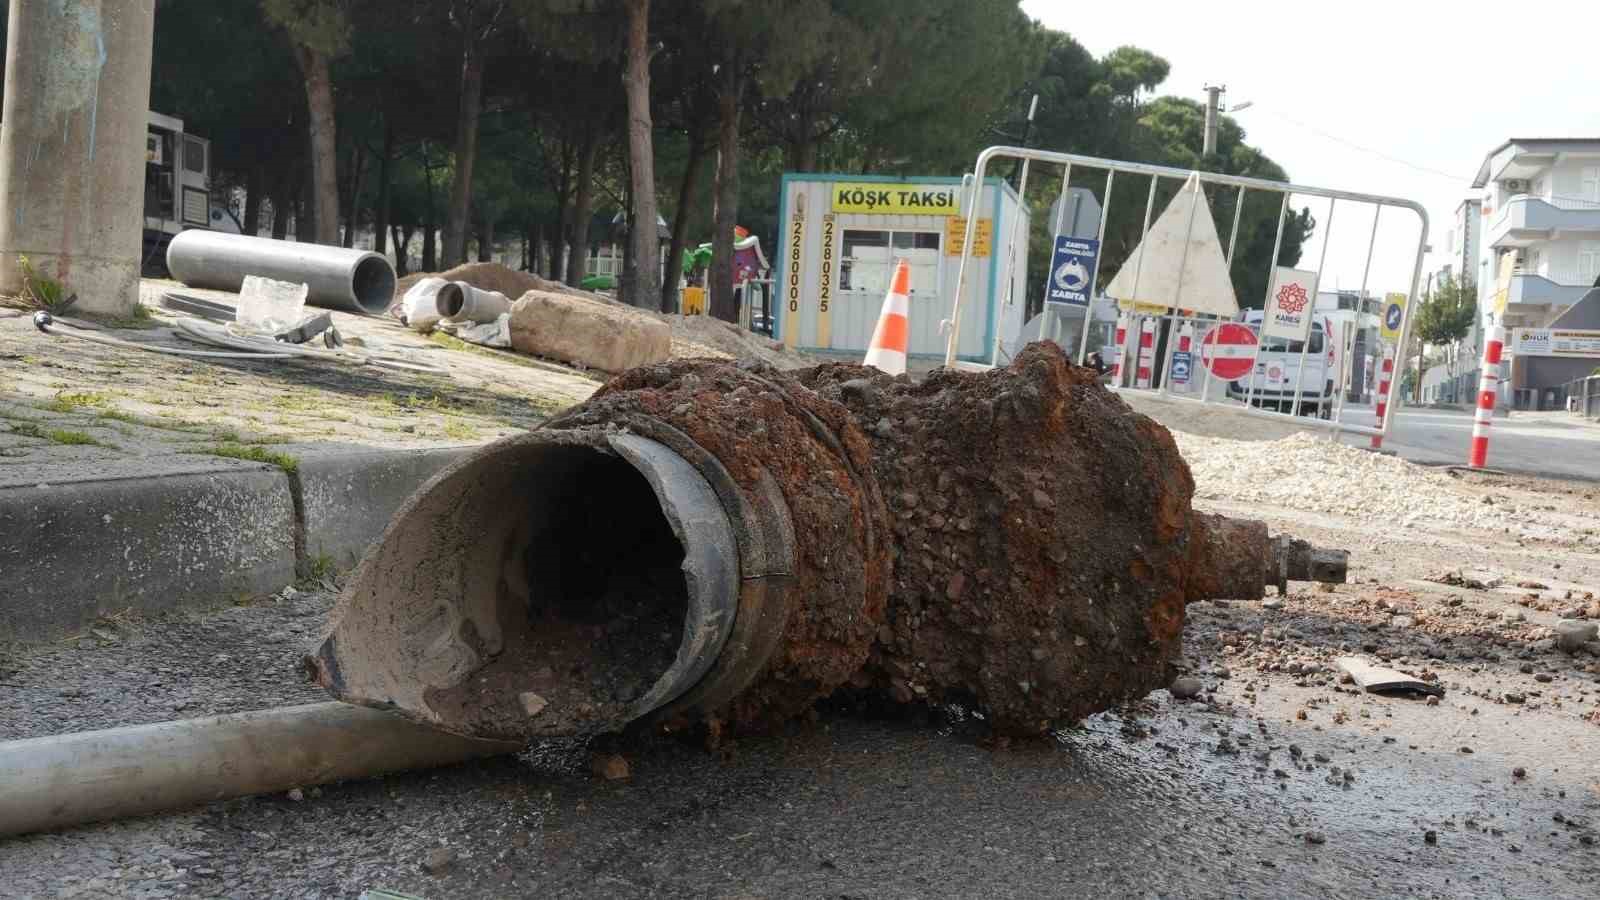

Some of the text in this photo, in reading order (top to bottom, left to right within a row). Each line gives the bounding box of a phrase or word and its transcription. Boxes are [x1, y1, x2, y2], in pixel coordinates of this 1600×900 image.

[839, 187, 954, 209] KÖŞK TAKSİ
[790, 223, 802, 312] 2280000
[820, 223, 833, 312] 2280325
[1051, 290, 1086, 301] ZABITA
